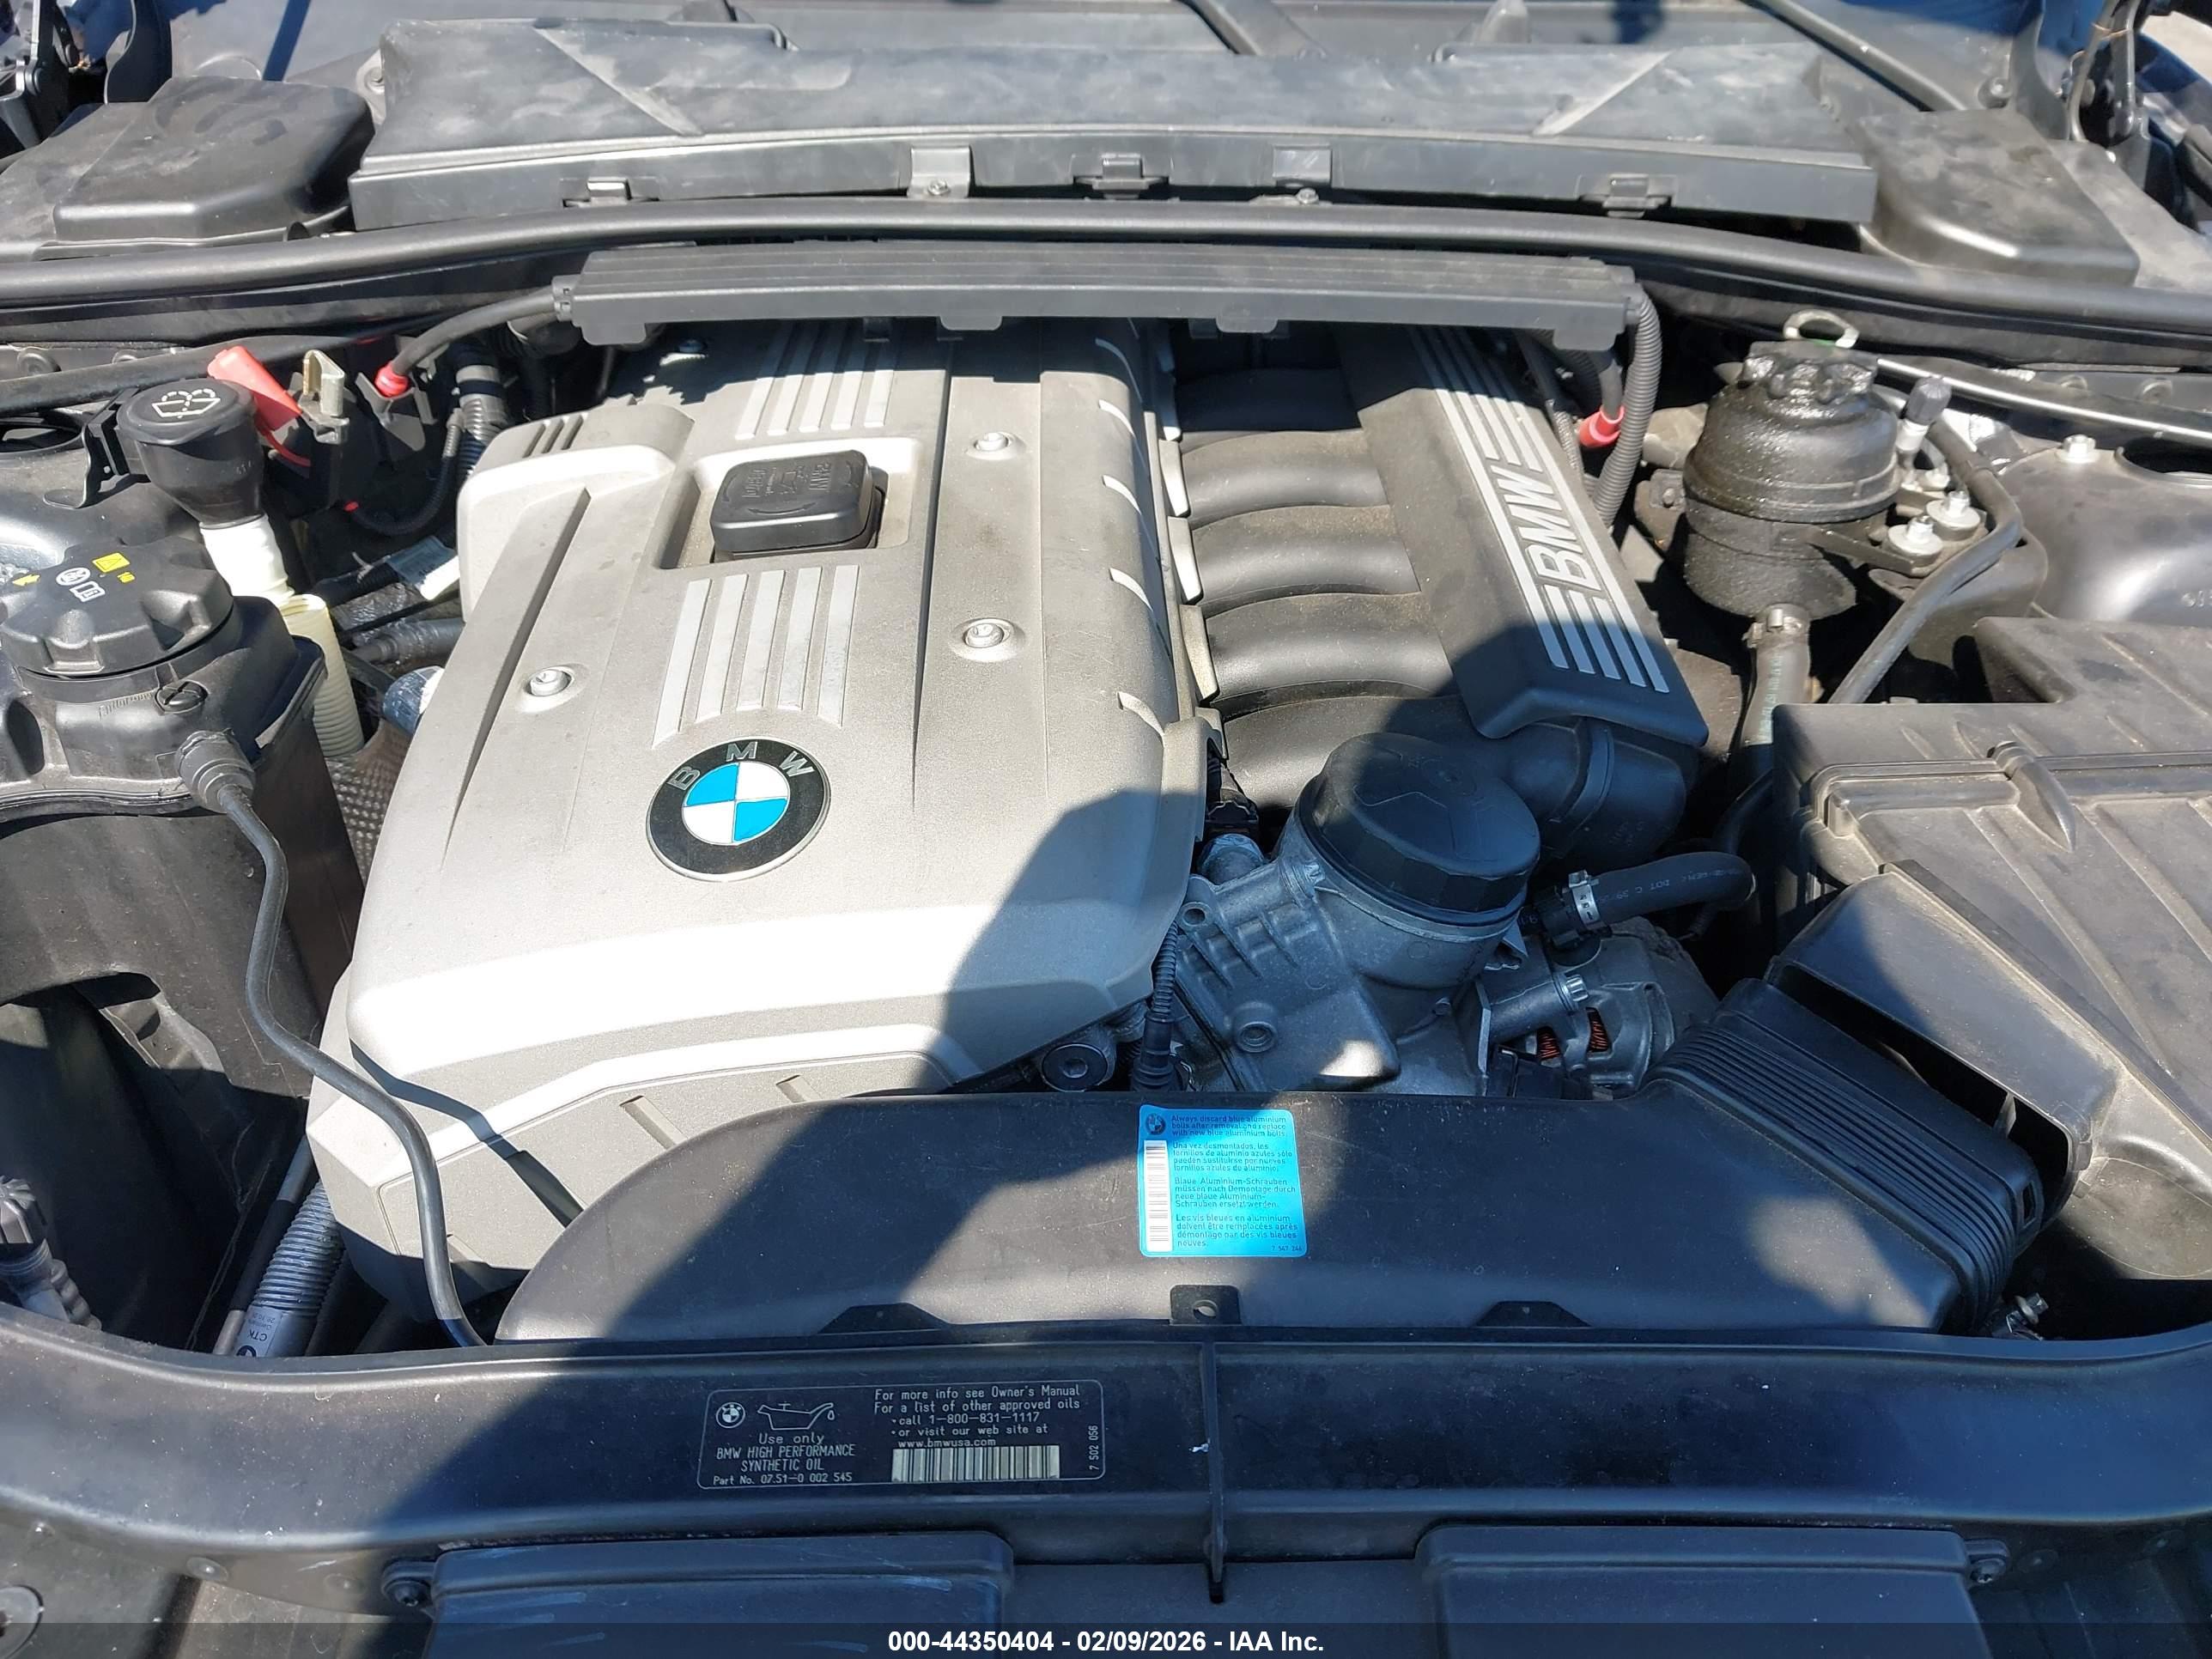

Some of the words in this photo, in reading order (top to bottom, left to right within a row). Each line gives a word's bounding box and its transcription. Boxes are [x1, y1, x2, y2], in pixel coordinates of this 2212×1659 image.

[1491, 465, 1601, 591] BMW
[666, 741, 814, 791] BMW
[875, 1389, 894, 1401] For
[901, 1391, 928, 1401] more
[936, 1387, 958, 1399] info
[965, 1389, 985, 1398] see
[991, 1385, 1035, 1398] Owner's
[1042, 1383, 1080, 1396] Manual
[874, 1401, 894, 1415] For
[900, 1404, 908, 1413] a
[915, 1401, 935, 1413] list
[942, 1400, 955, 1412] of
[962, 1399, 993, 1411] other
[1000, 1397, 1051, 1413] approved
[1057, 1397, 1080, 1409] oils
[929, 1411, 1041, 1425] 1-800-831-1117
[758, 1432, 784, 1444] Use
[793, 1431, 824, 1445] only
[917, 1425, 945, 1437] visit
[977, 1425, 1000, 1435] web
[1006, 1425, 1029, 1434] site
[1036, 1424, 1048, 1434] at
[1088, 1425, 1099, 1441] 056
[898, 1437, 996, 1448] www.bmwusa.com
[716, 1447, 742, 1460] BMW
[747, 1446, 774, 1458] HIGH
[778, 1443, 856, 1457] PERFORMANCE
[1089, 1444, 1099, 1461] 502
[741, 1460, 800, 1473] SYNTHETIC
[805, 1459, 825, 1471] OIL
[713, 1475, 735, 1486] Part
[739, 1474, 755, 1485] No.
[760, 1473, 805, 1485] 07.51-0
[809, 1472, 828, 1483] 002
[833, 1472, 853, 1482] 545
